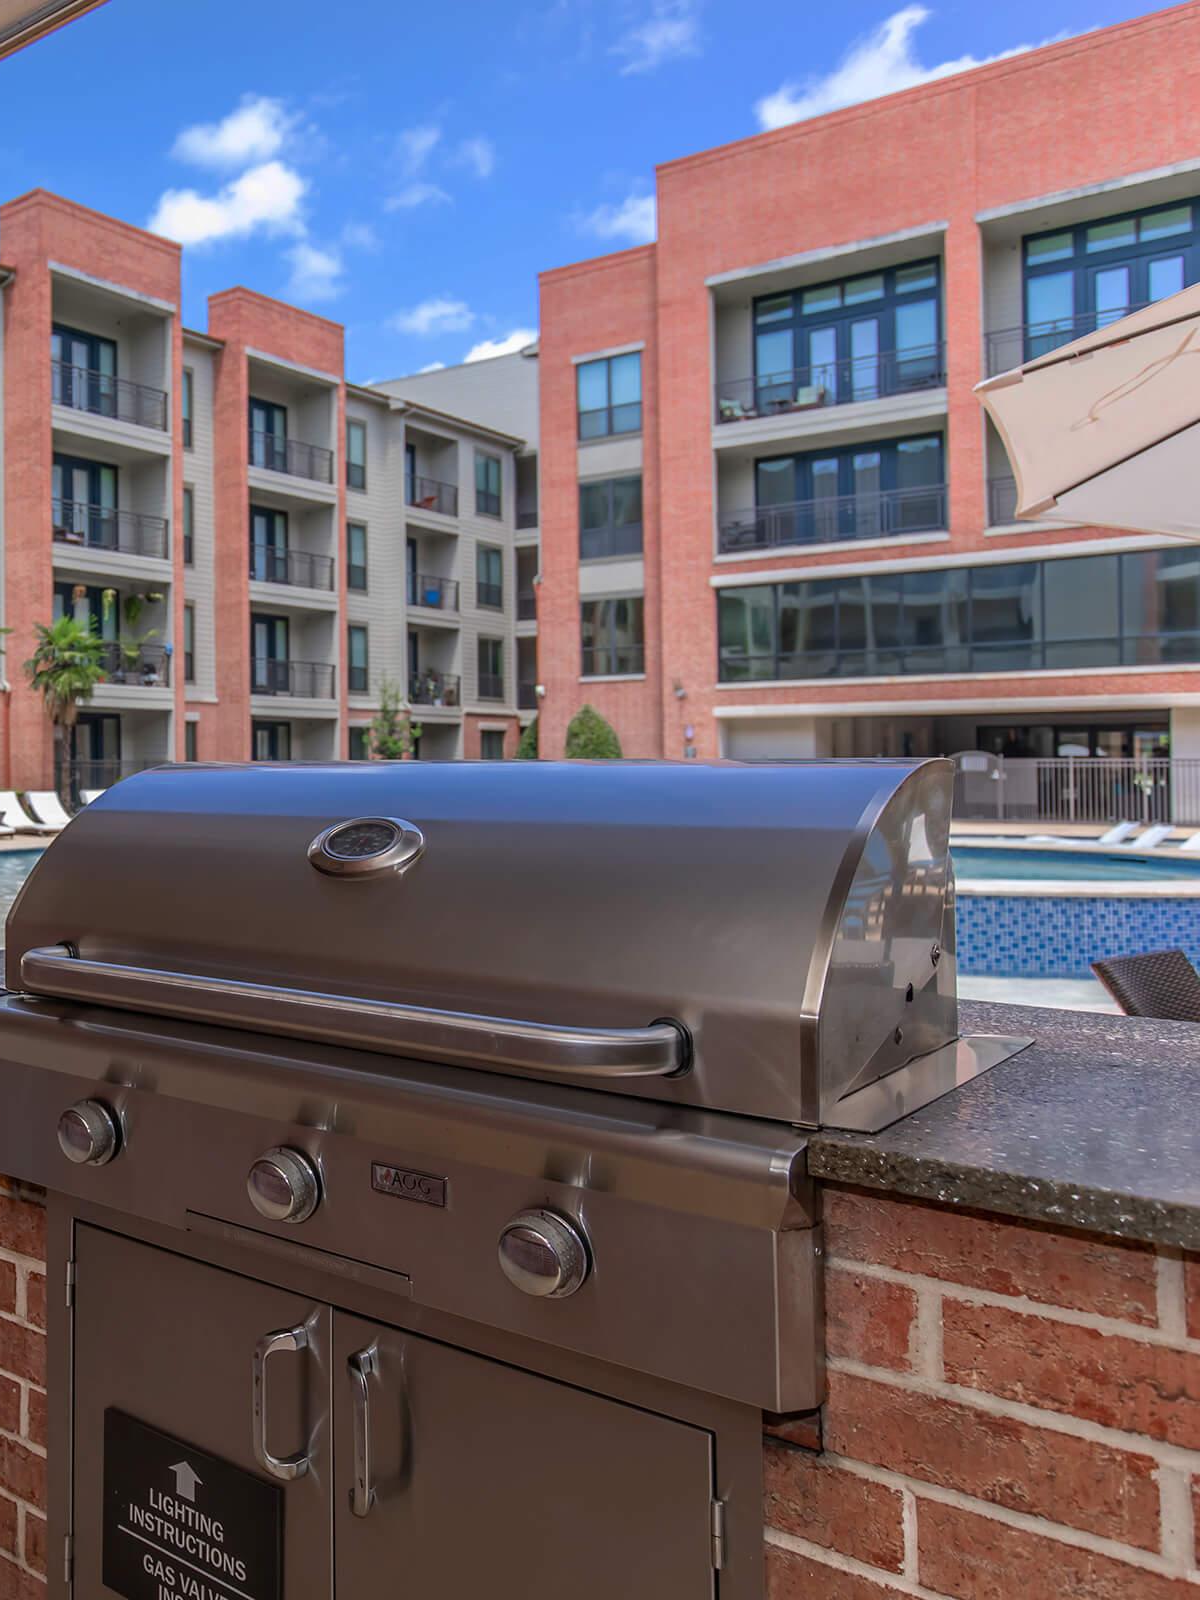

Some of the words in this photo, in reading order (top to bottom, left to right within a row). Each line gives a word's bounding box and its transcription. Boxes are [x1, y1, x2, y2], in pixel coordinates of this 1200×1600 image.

[129, 1503, 246, 1581] INSTRUCTIONS
[149, 1487, 224, 1543] LIGHTING
[143, 1554, 176, 1586] GAS
[180, 1572, 229, 1600] VALV
